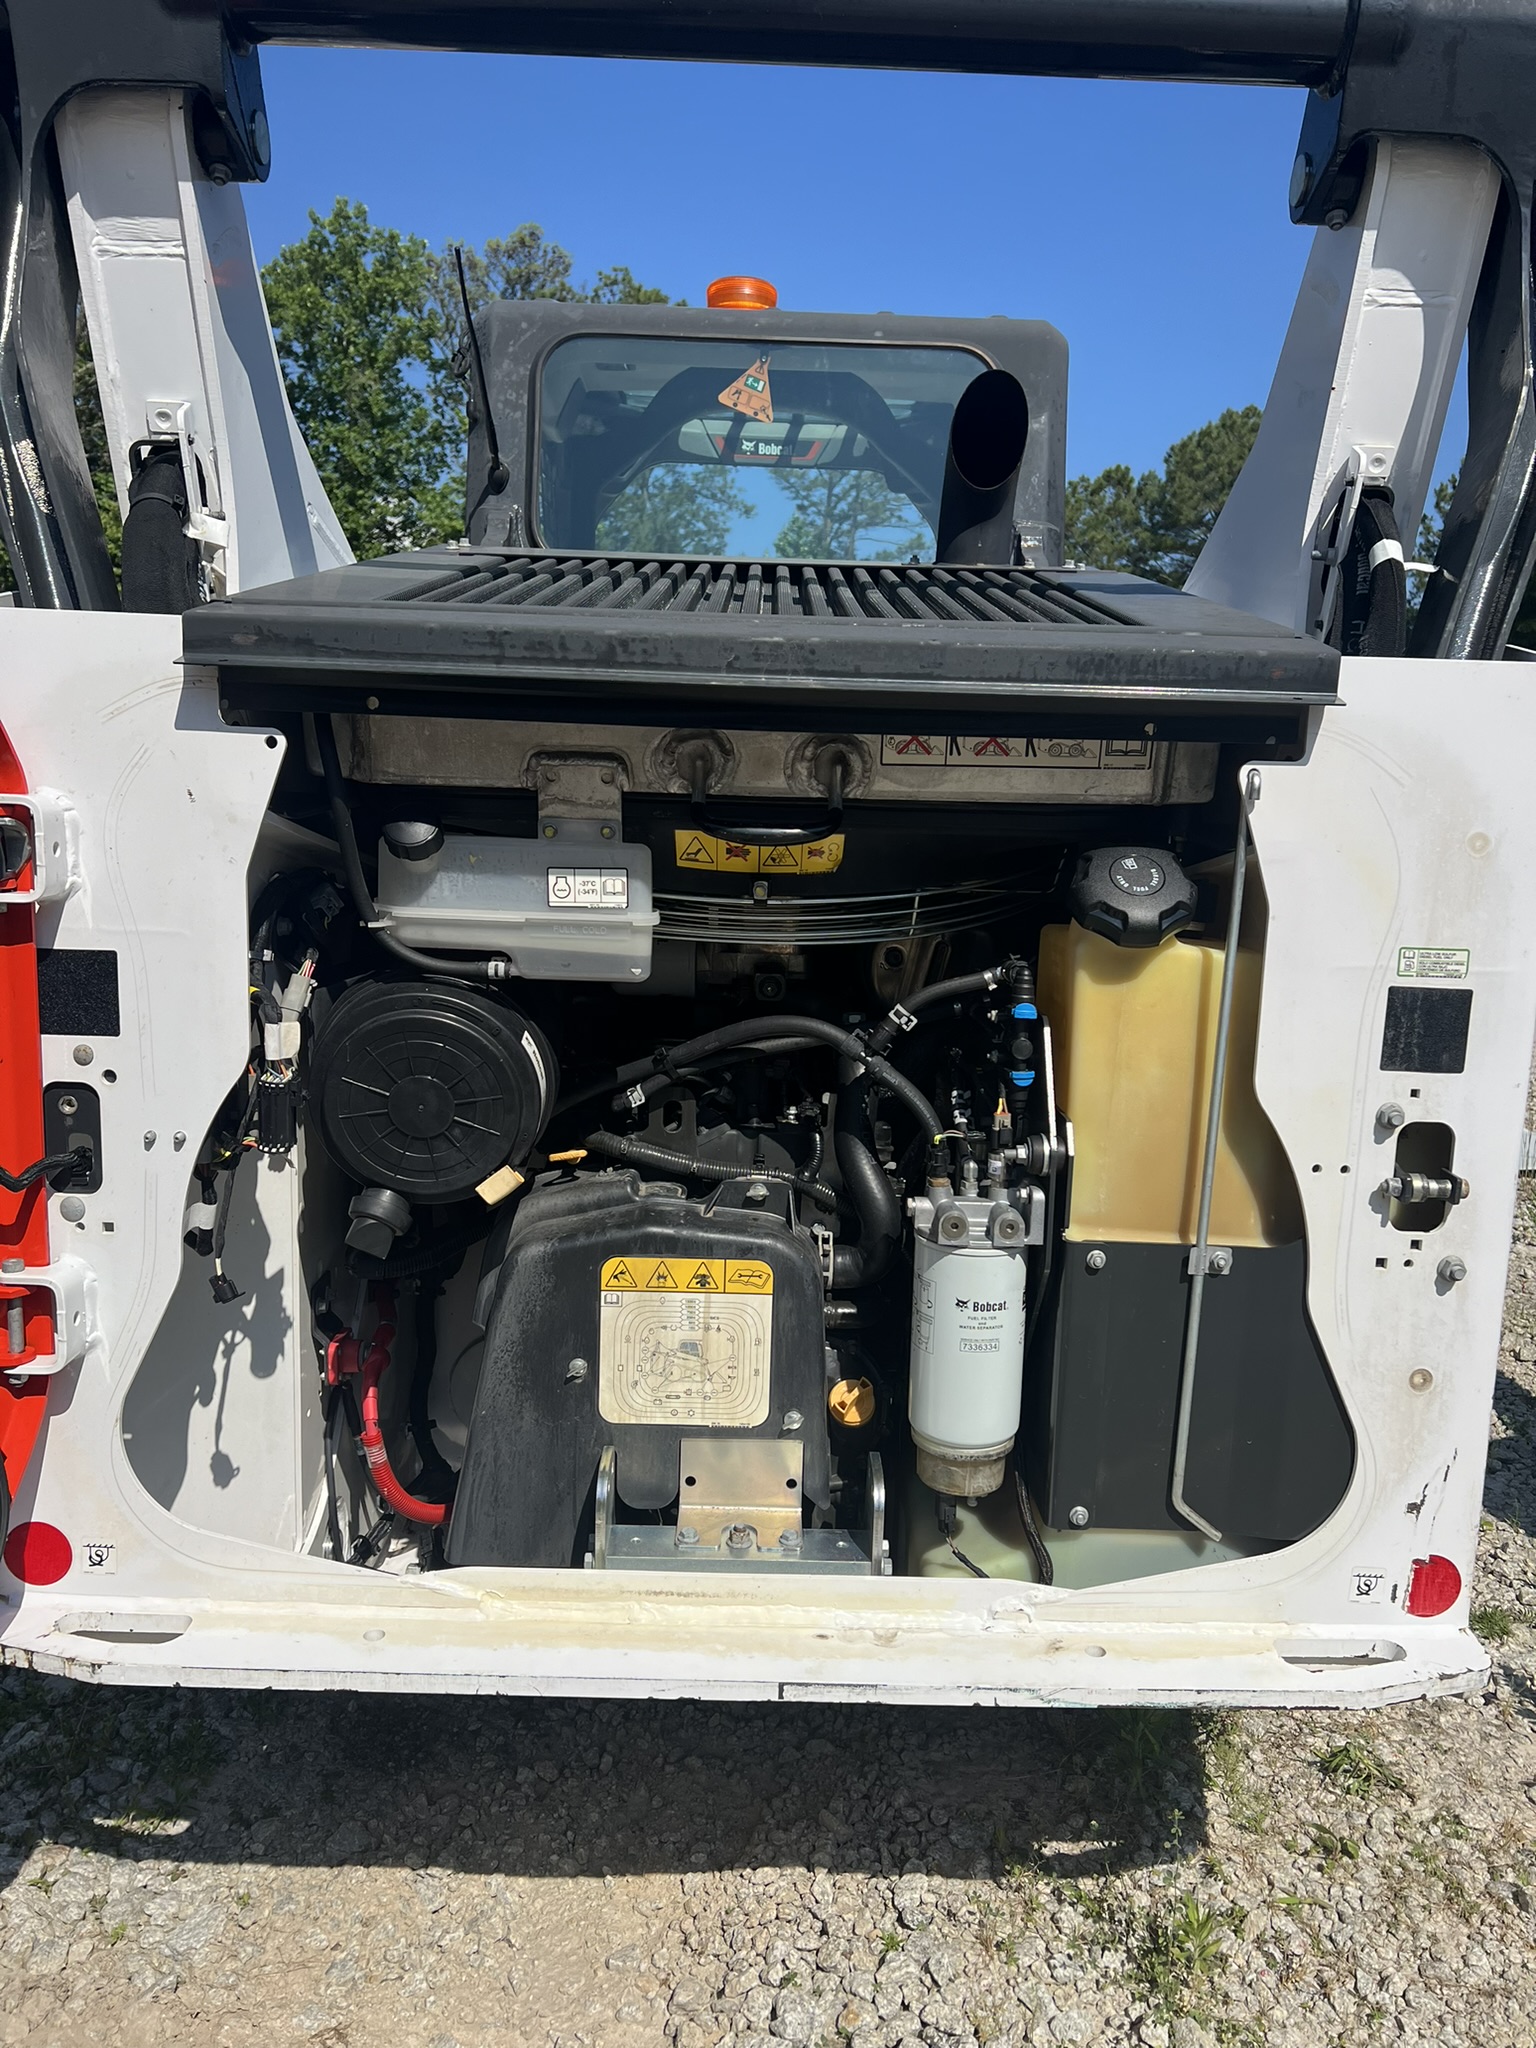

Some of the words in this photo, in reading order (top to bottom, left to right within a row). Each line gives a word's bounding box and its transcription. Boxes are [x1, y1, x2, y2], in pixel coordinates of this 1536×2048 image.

[553, 925, 577, 934] FULL
[582, 926, 607, 935] COLD
[972, 1300, 1008, 1312] Bobcat
[962, 1343, 998, 1351] 7336334
